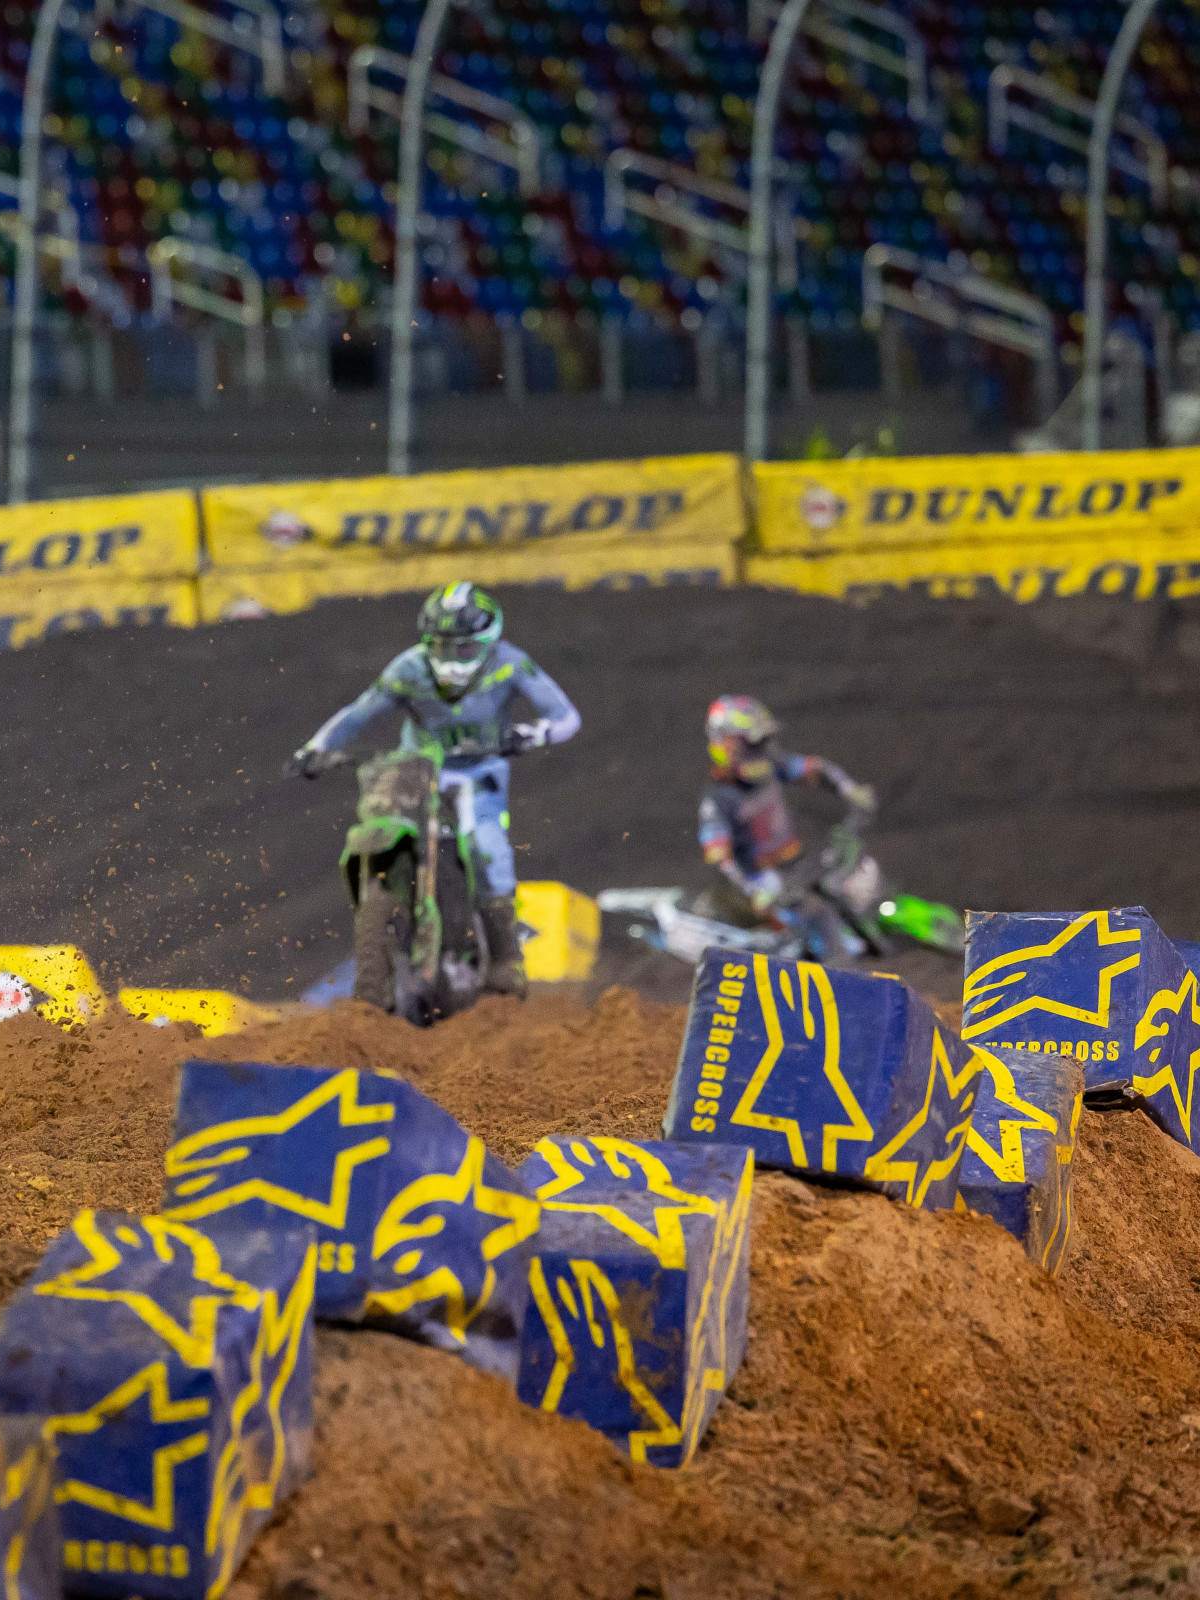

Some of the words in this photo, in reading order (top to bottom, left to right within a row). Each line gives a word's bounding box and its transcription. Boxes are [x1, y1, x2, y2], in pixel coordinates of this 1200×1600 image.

[338, 489, 686, 547] DUNLOP
[866, 476, 1184, 526] DUNLOP
[690, 962, 748, 1134] SUPERCROSS
